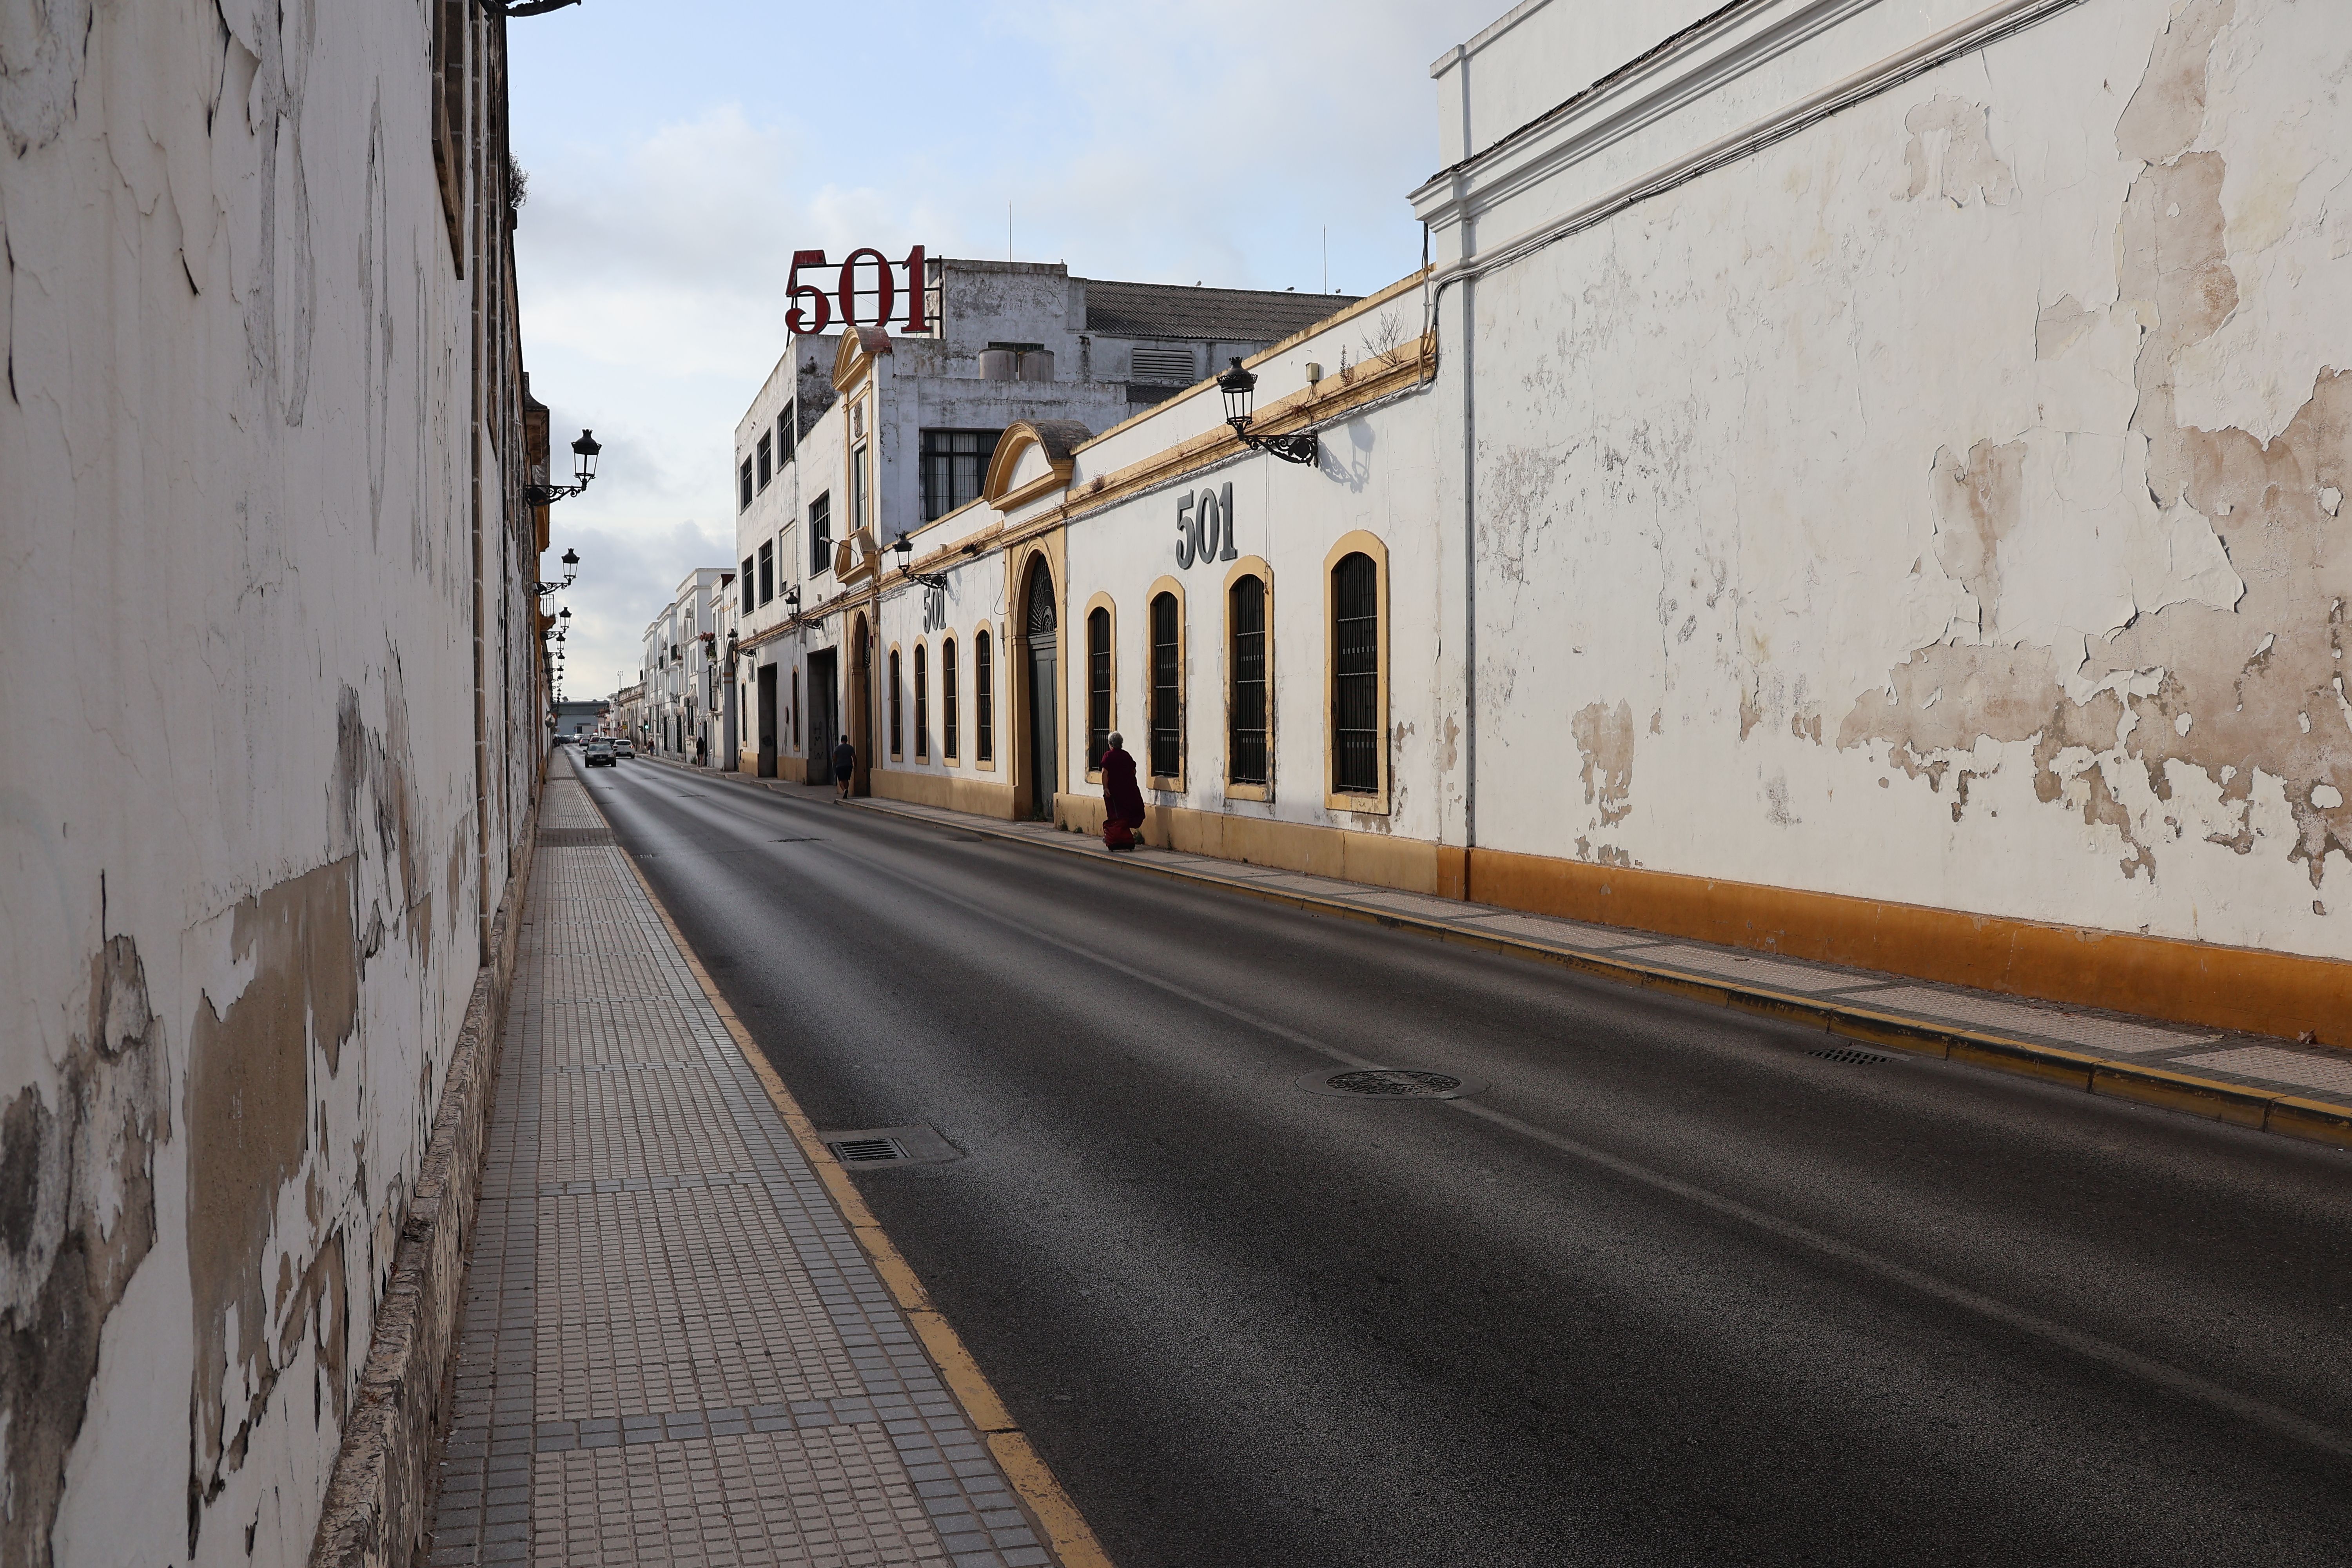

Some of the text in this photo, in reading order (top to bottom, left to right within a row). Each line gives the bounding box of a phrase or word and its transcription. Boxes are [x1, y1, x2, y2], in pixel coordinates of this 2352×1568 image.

[785, 245, 933, 334] 501
[1176, 481, 1238, 570] 501
[923, 587, 946, 634] 501
